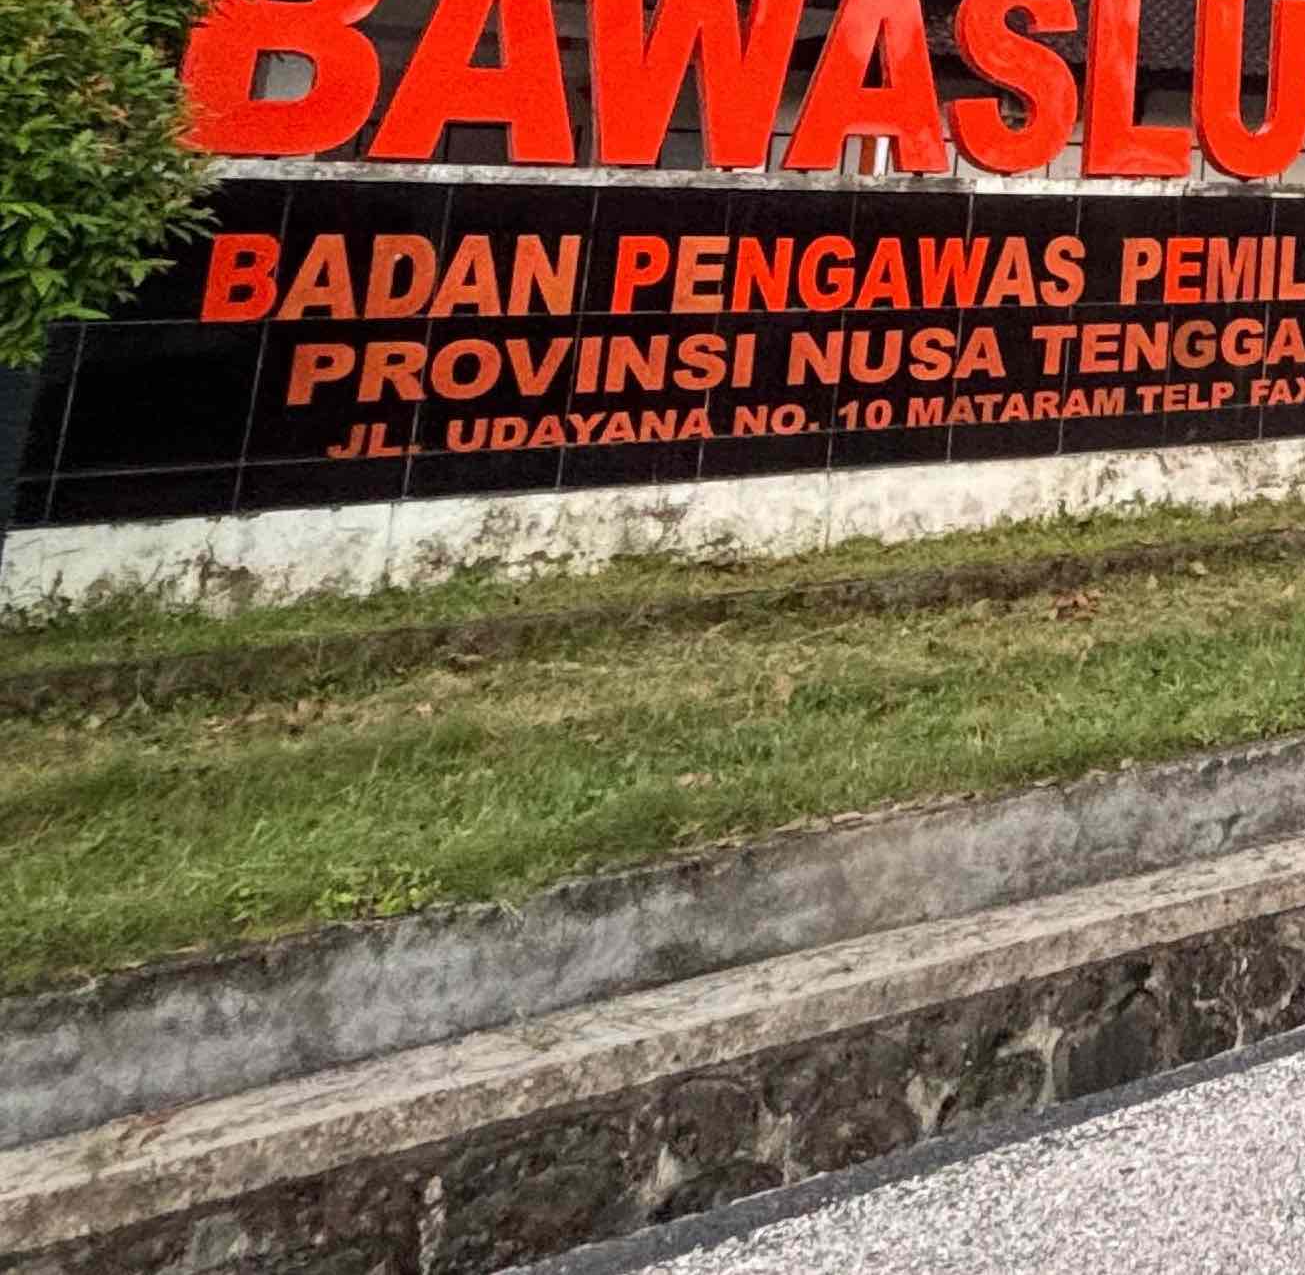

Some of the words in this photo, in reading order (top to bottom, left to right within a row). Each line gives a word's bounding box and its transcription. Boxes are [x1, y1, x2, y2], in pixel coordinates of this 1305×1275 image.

[200, 233, 582, 323] BADAN
[611, 234, 1087, 314] PENGAWAS
[286, 334, 757, 405] PROVINSI
[786, 326, 1006, 386] NUSA
[326, 423, 421, 459] JL.
[446, 408, 711, 453] UDAYANA
[733, 403, 820, 437] NO.
[838, 399, 893, 431] 10
[906, 387, 1126, 428] MATARAM
[1136, 381, 1235, 416] TELP
